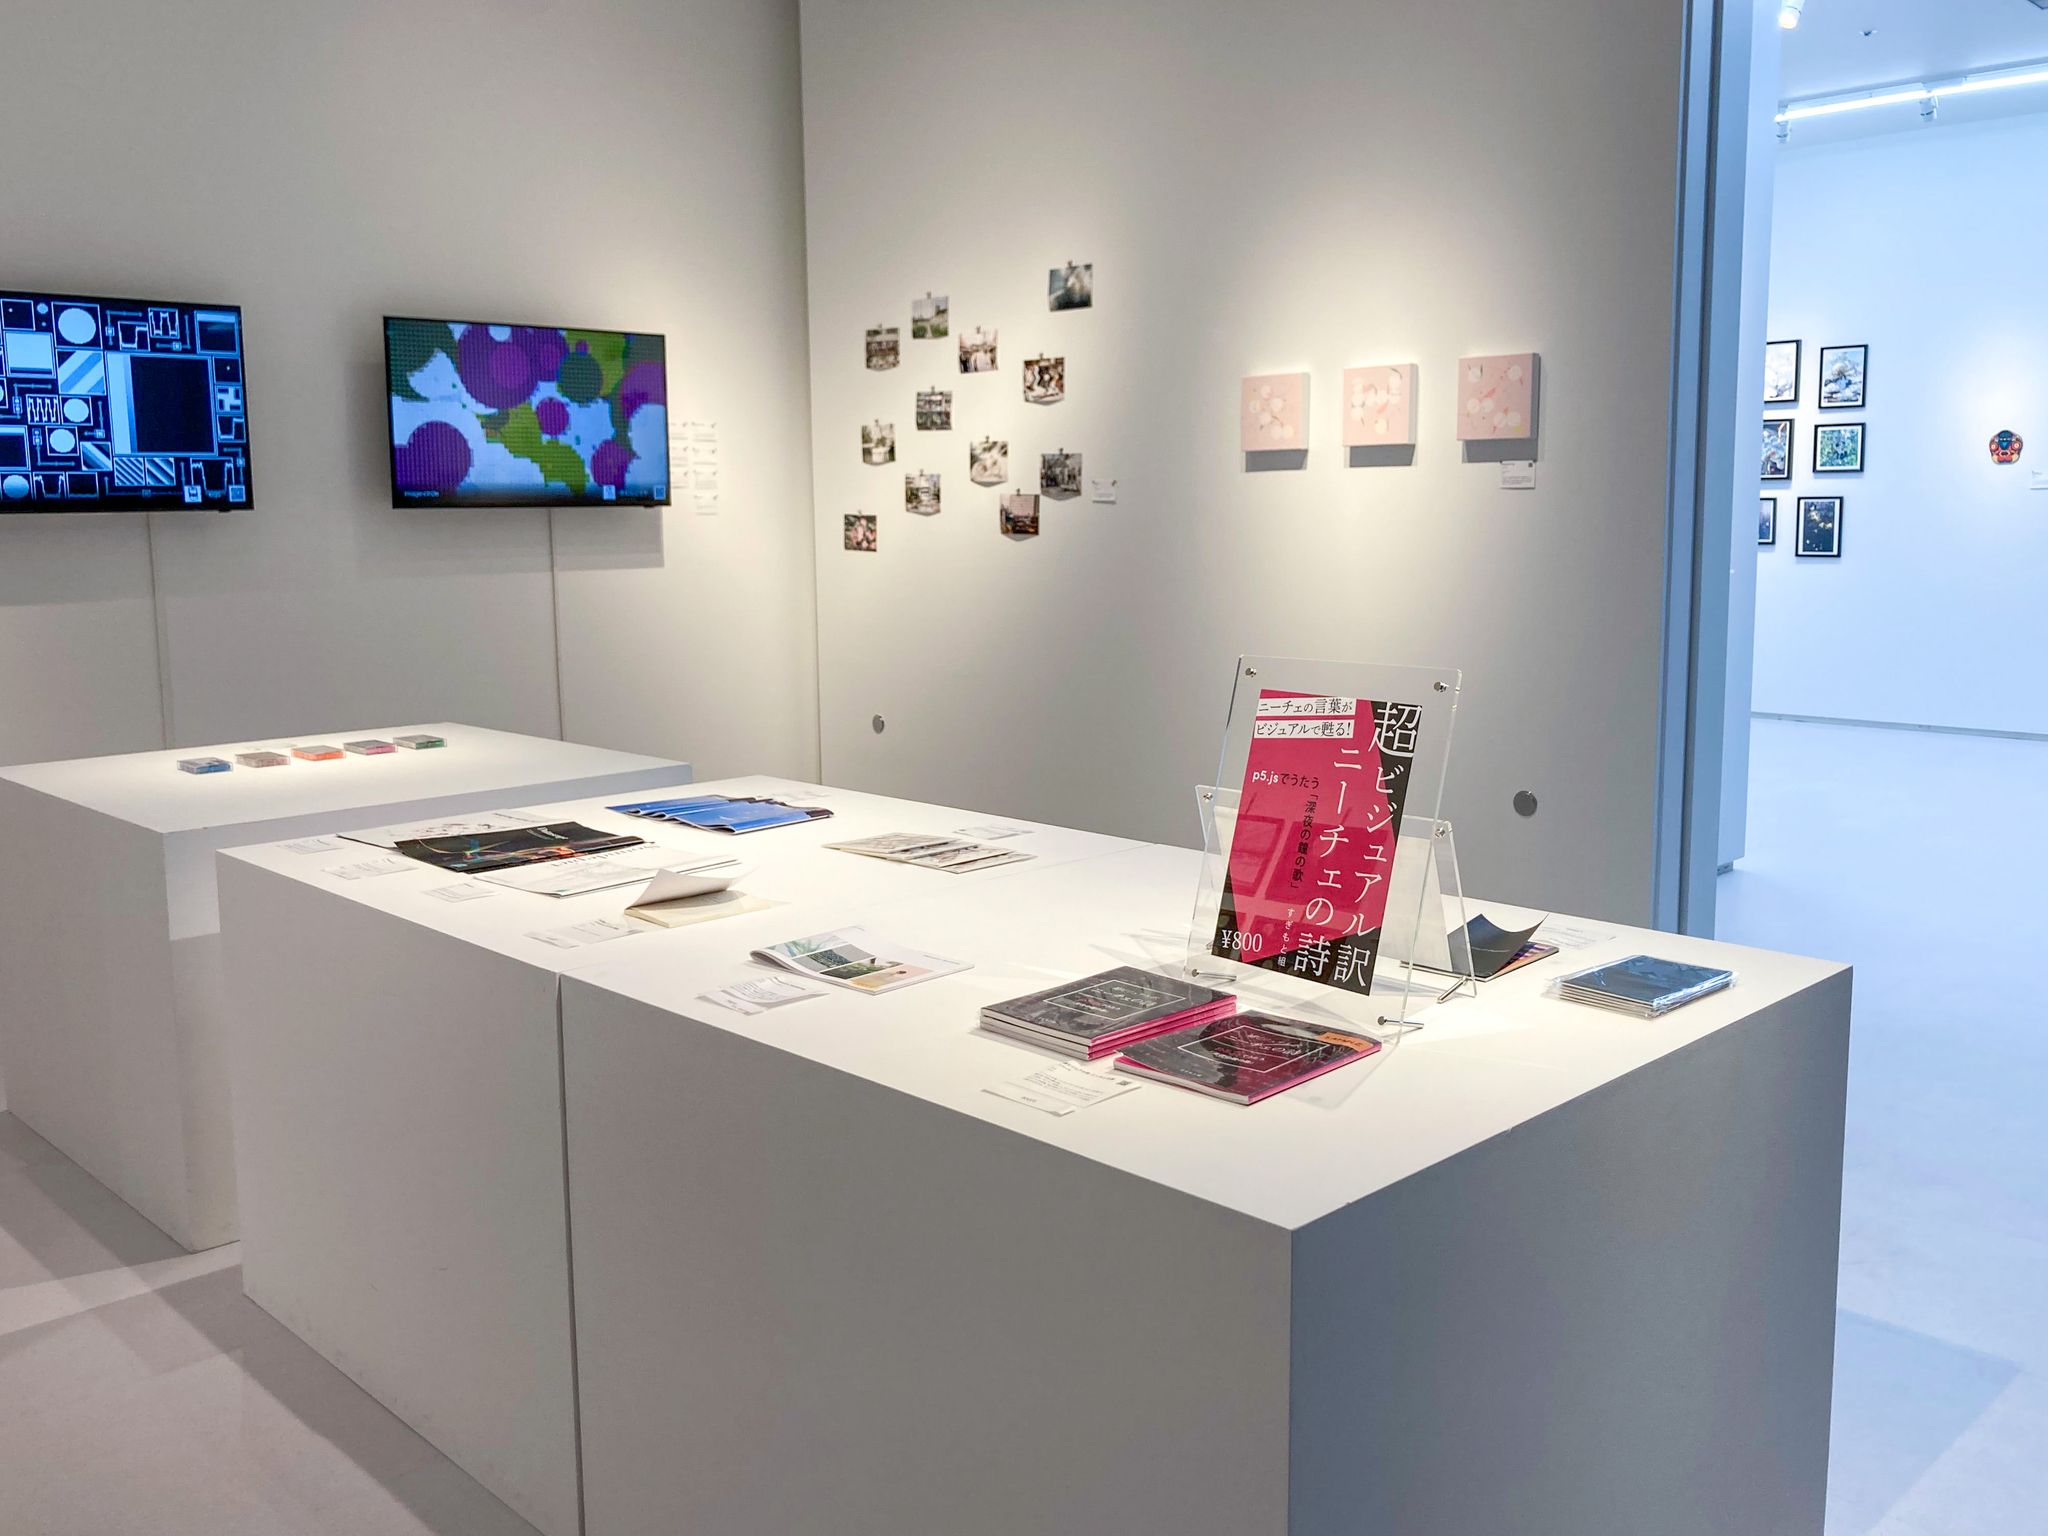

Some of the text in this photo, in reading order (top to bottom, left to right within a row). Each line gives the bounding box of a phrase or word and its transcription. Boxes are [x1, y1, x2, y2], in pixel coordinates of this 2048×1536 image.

[1258, 698, 1353, 714] ニーチェの言葉が
[1256, 720, 1351, 738] ビジュアルで甦る!
[1333, 702, 1423, 987] 超ビジュアル訳
[1293, 747, 1362, 977] ニーチェの詩
[1221, 929, 1263, 953] ¥800
